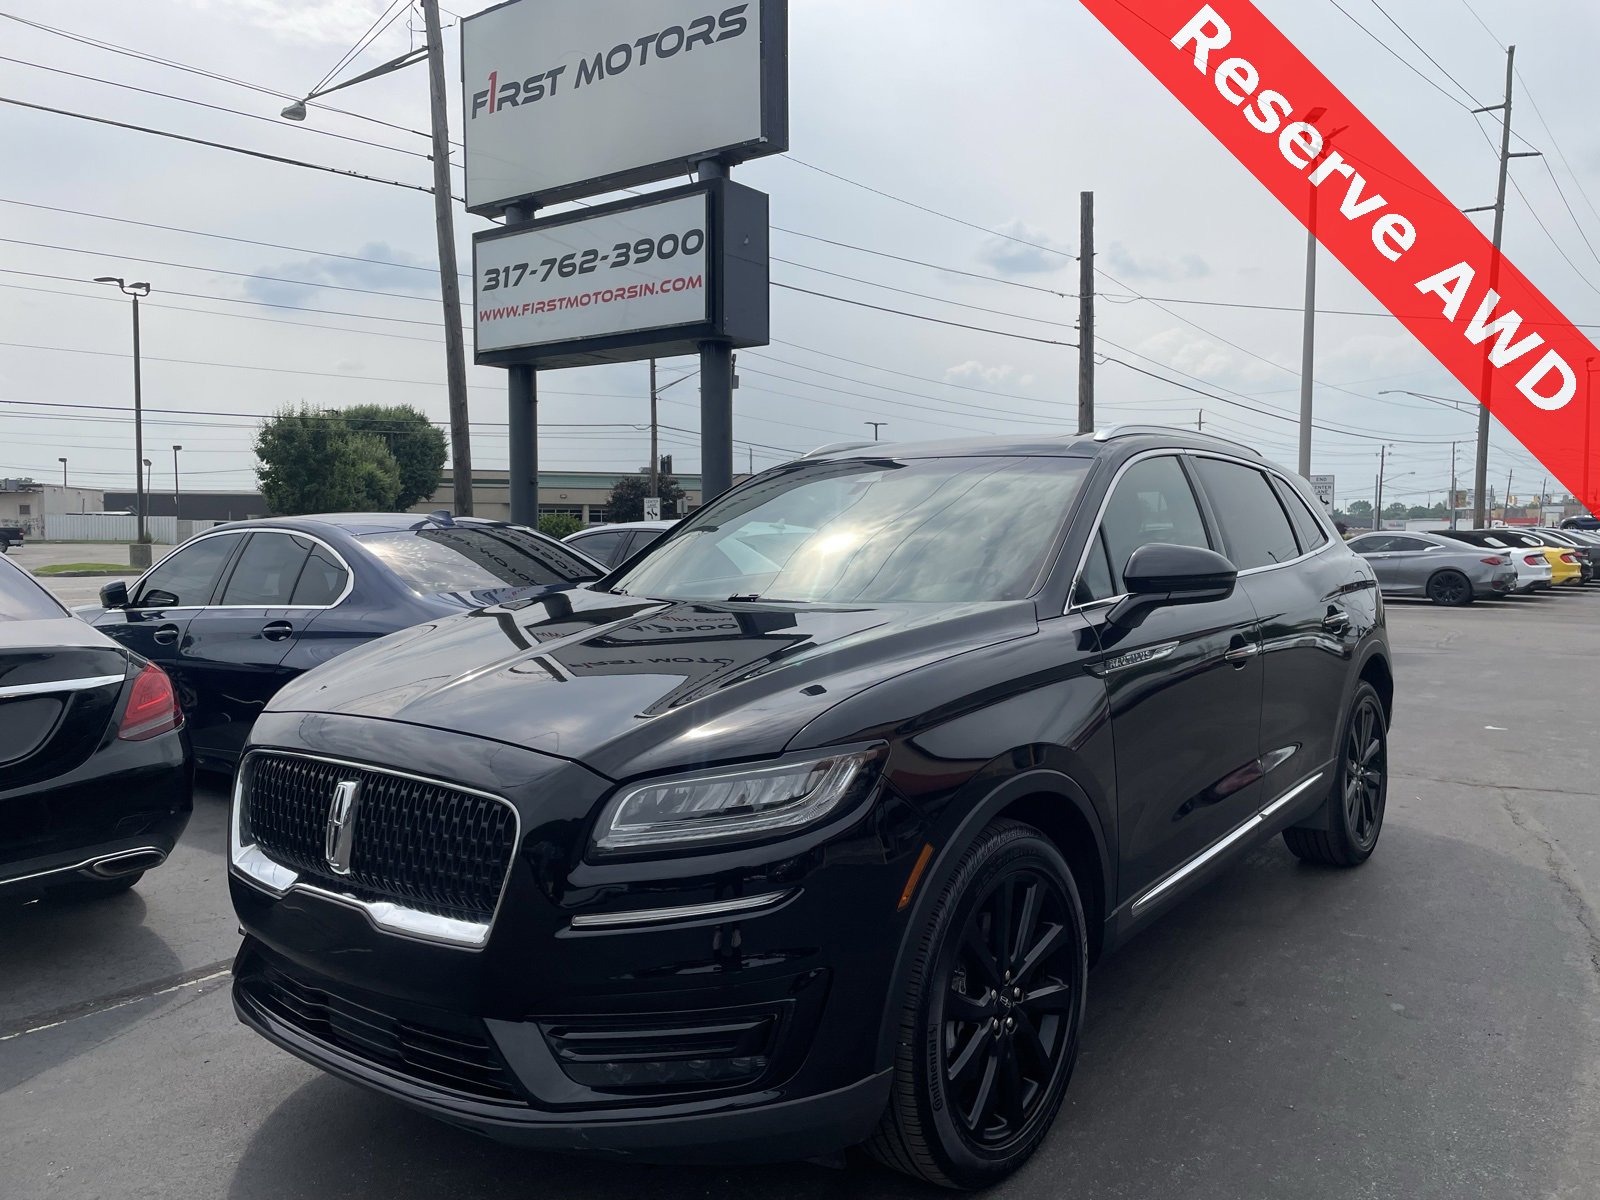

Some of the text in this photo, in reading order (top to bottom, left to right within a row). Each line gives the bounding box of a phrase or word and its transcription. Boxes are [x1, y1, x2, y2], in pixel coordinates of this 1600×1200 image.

[573, 3, 749, 89] MOTORS
[482, 228, 705, 292] 317-762-3900
[479, 275, 703, 322] WWW.FIRSTMOTORSIN.COM
